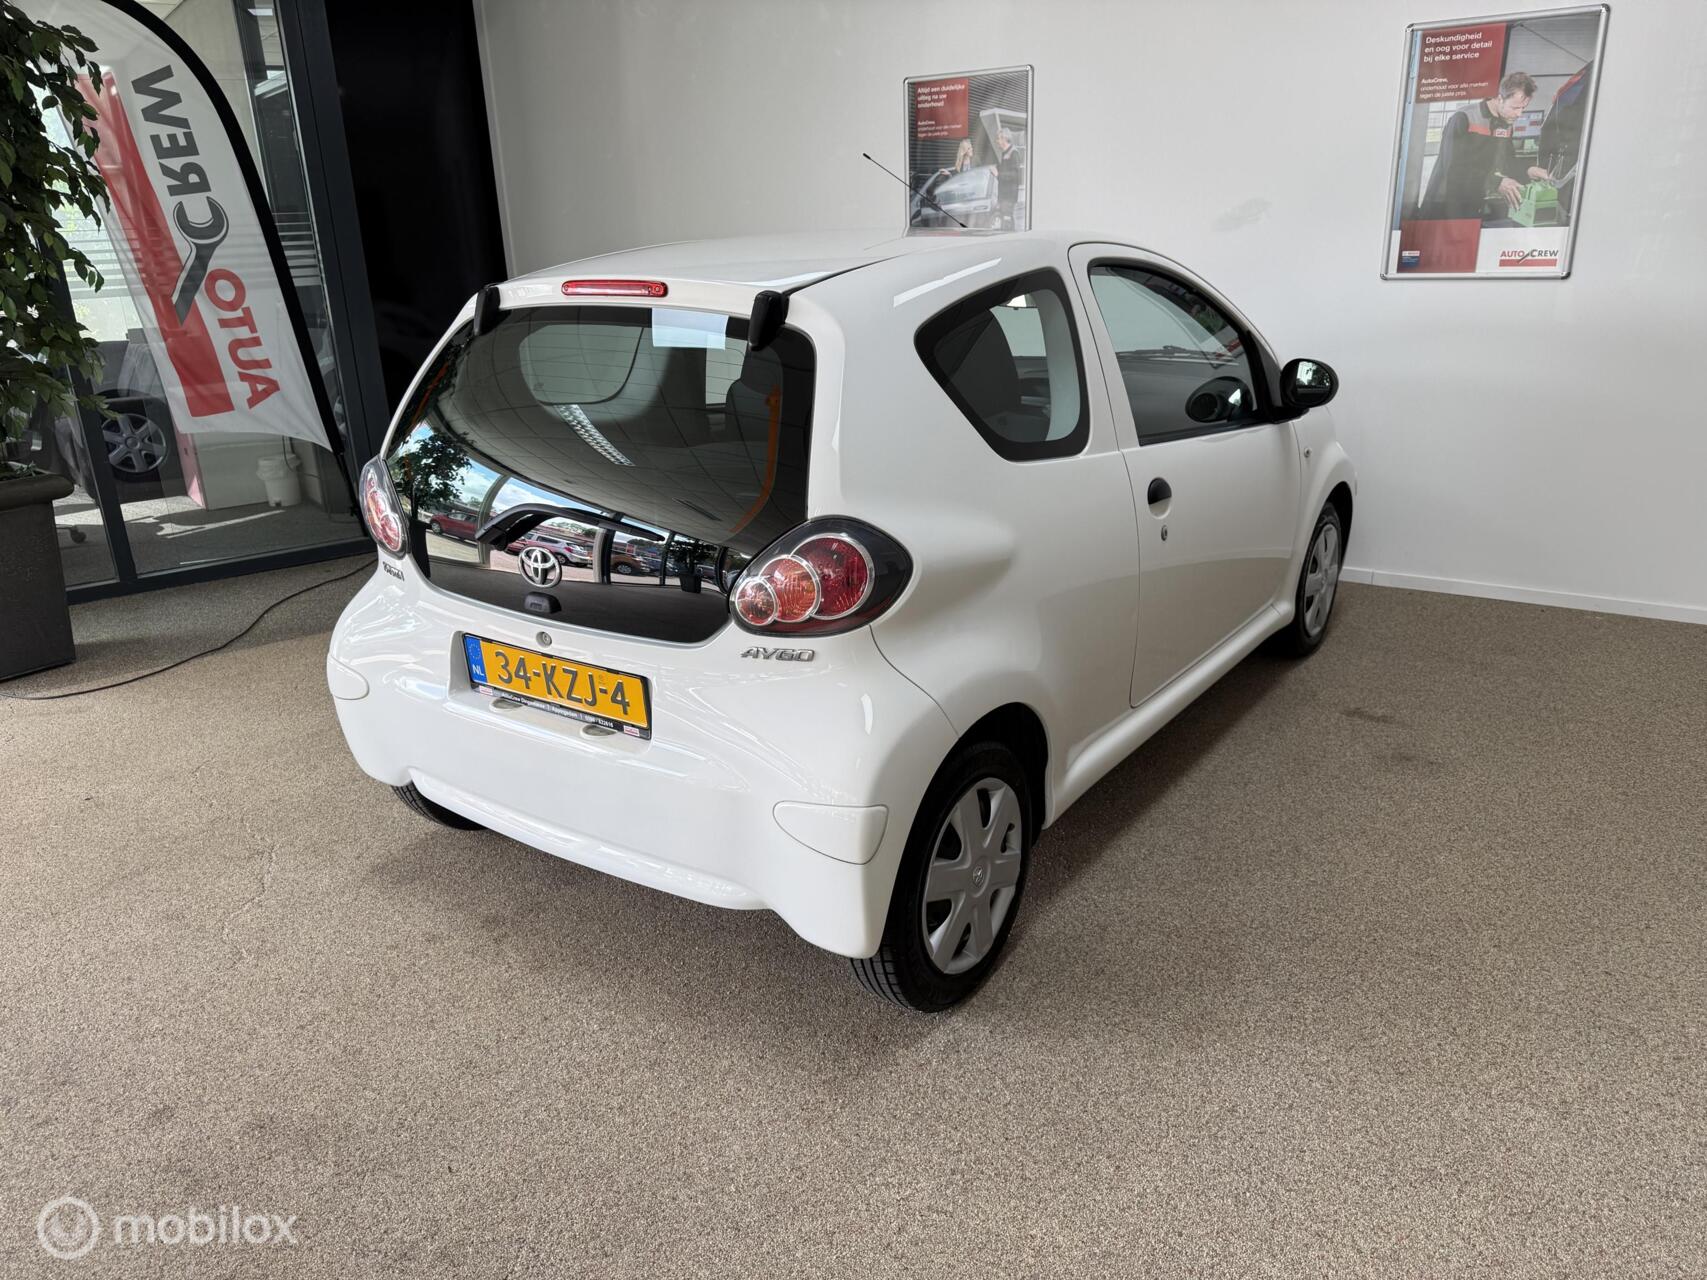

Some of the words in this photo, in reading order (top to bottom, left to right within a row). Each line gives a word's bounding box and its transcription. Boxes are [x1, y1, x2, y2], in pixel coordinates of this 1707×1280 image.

[1425, 32, 1482, 44] Deskundigheid
[1470, 40, 1493, 49] detail
[1423, 55, 1433, 63] bij
[1434, 54, 1451, 62] elke
[1451, 52, 1480, 60] service
[1500, 250, 1525, 258] AUTO
[1530, 249, 1559, 258] CREW
[740, 646, 815, 662] AYGO
[472, 664, 484, 677] NL
[494, 650, 631, 716] 34-KZJ-4
